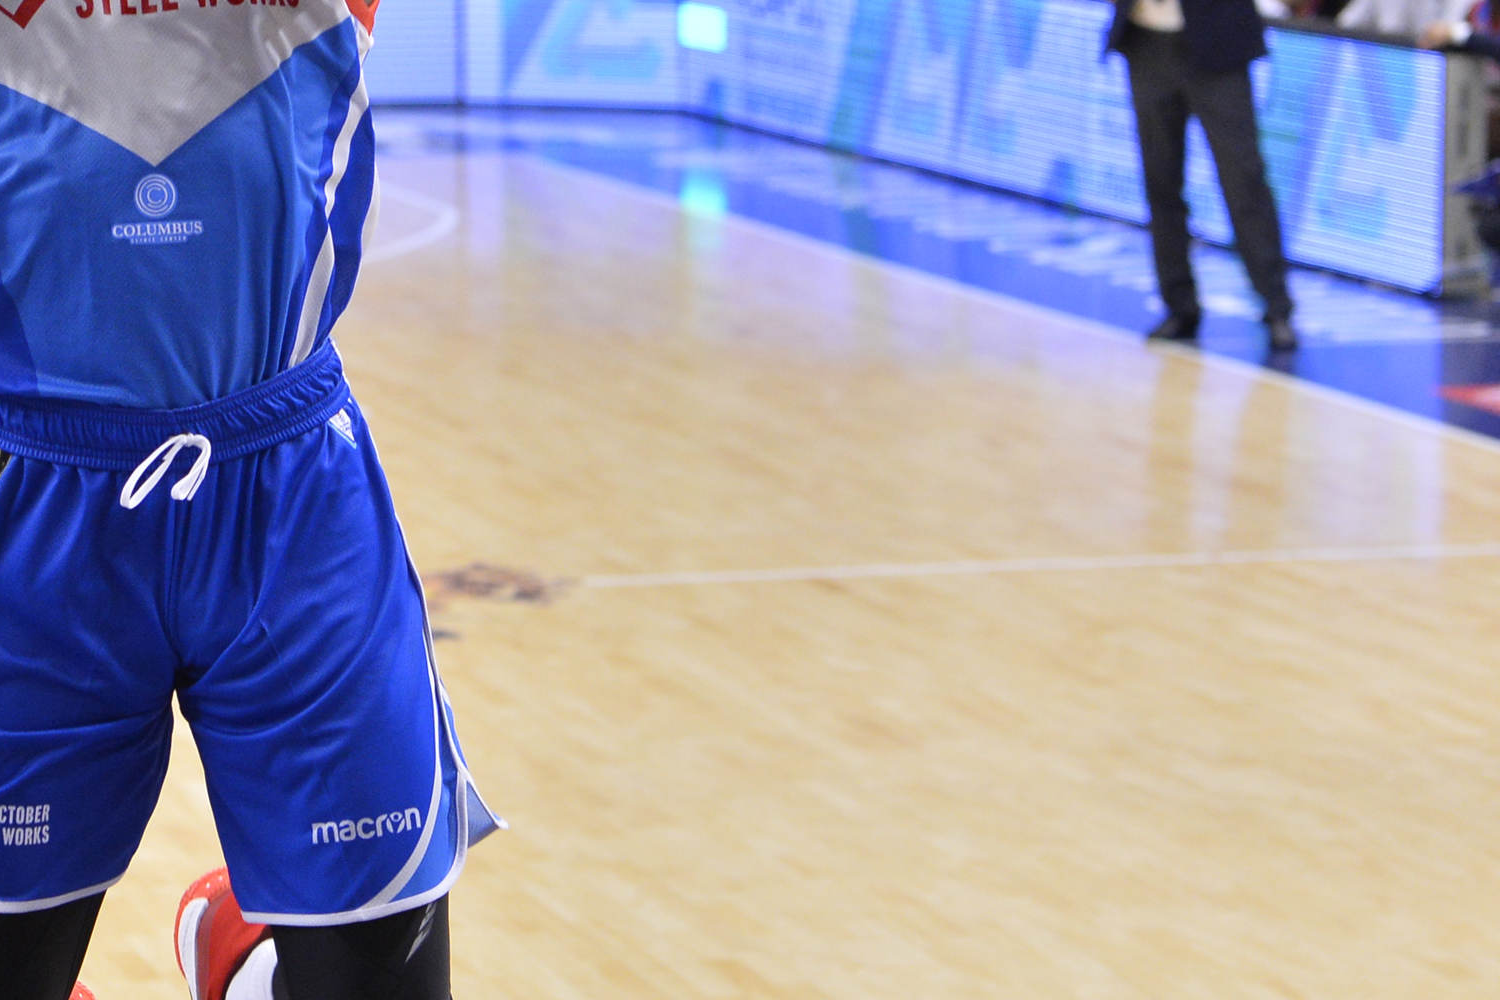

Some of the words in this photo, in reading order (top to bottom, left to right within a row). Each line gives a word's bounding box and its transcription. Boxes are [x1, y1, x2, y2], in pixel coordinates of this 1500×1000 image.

[112, 220, 203, 238] COLUMBUS
[2, 824, 50, 846] WORKS
[311, 807, 422, 845] macron
